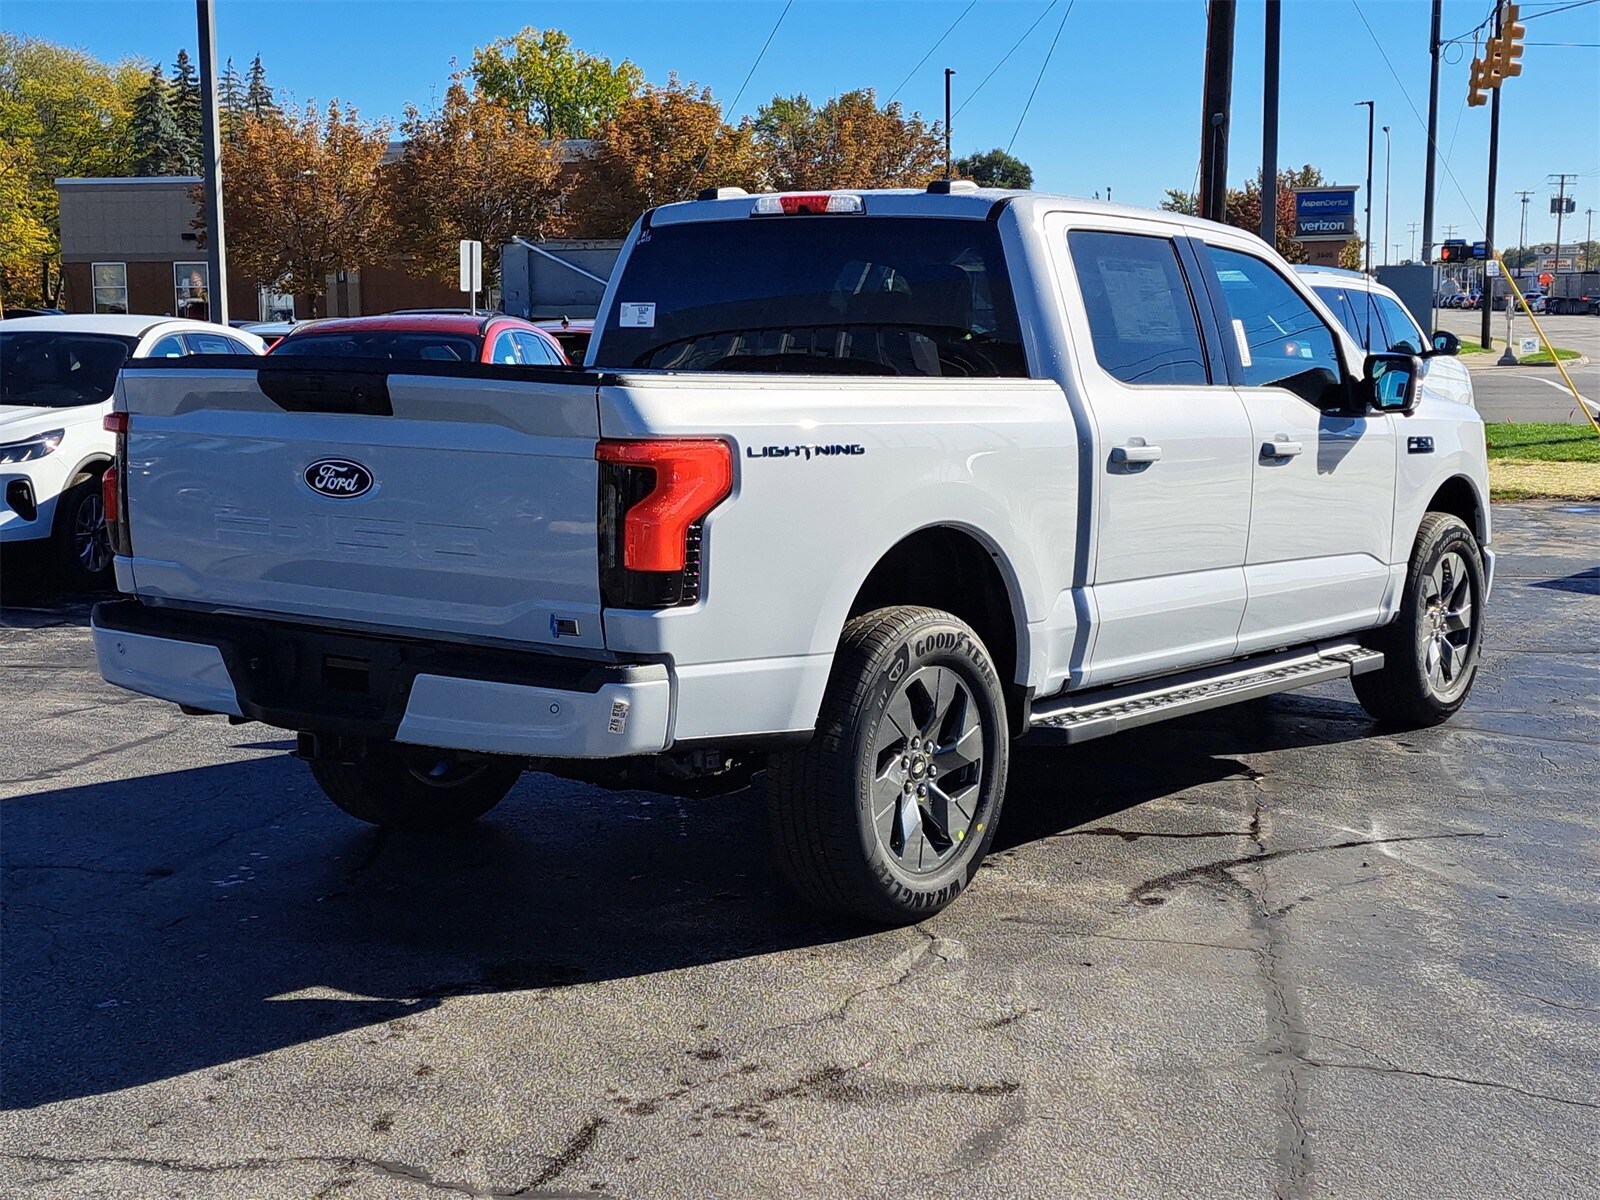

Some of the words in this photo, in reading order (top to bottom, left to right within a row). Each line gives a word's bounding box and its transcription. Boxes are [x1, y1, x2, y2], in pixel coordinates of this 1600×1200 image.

[1300, 220, 1345, 231] verizon
[746, 444, 866, 461] LIGHTNING
[315, 464, 359, 491] Ford
